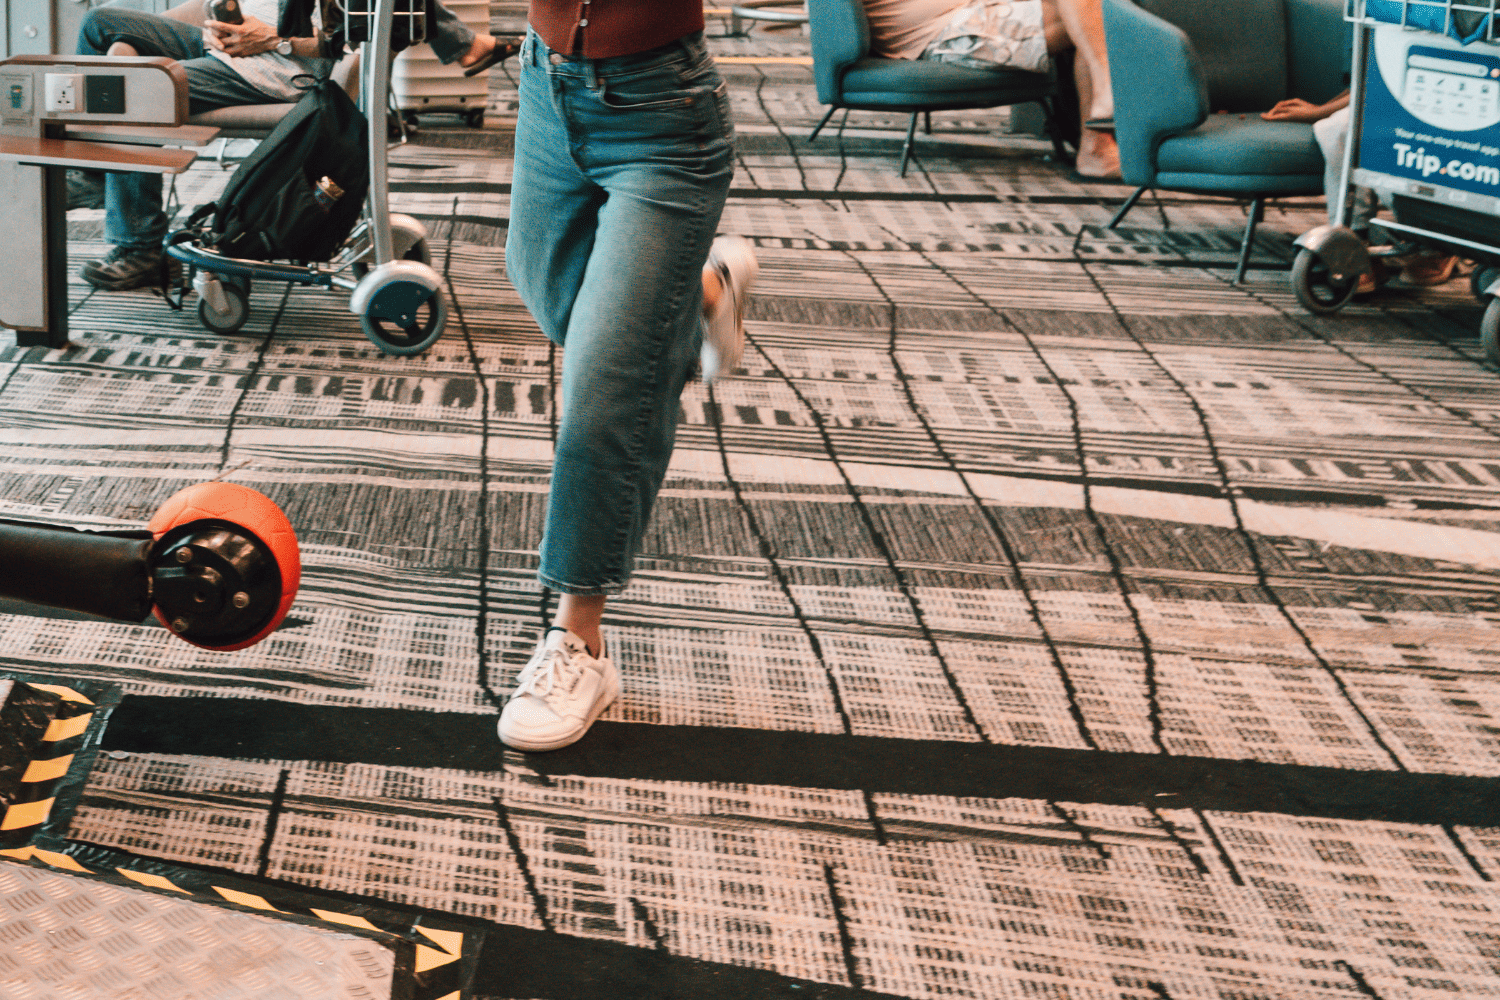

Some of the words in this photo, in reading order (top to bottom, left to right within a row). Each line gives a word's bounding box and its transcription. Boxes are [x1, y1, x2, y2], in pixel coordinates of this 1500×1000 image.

[1394, 126, 1415, 138] Your
[1415, 131, 1454, 148] one-stop
[1454, 136, 1480, 151] travel
[1393, 143, 1500, 186] Trip.com
